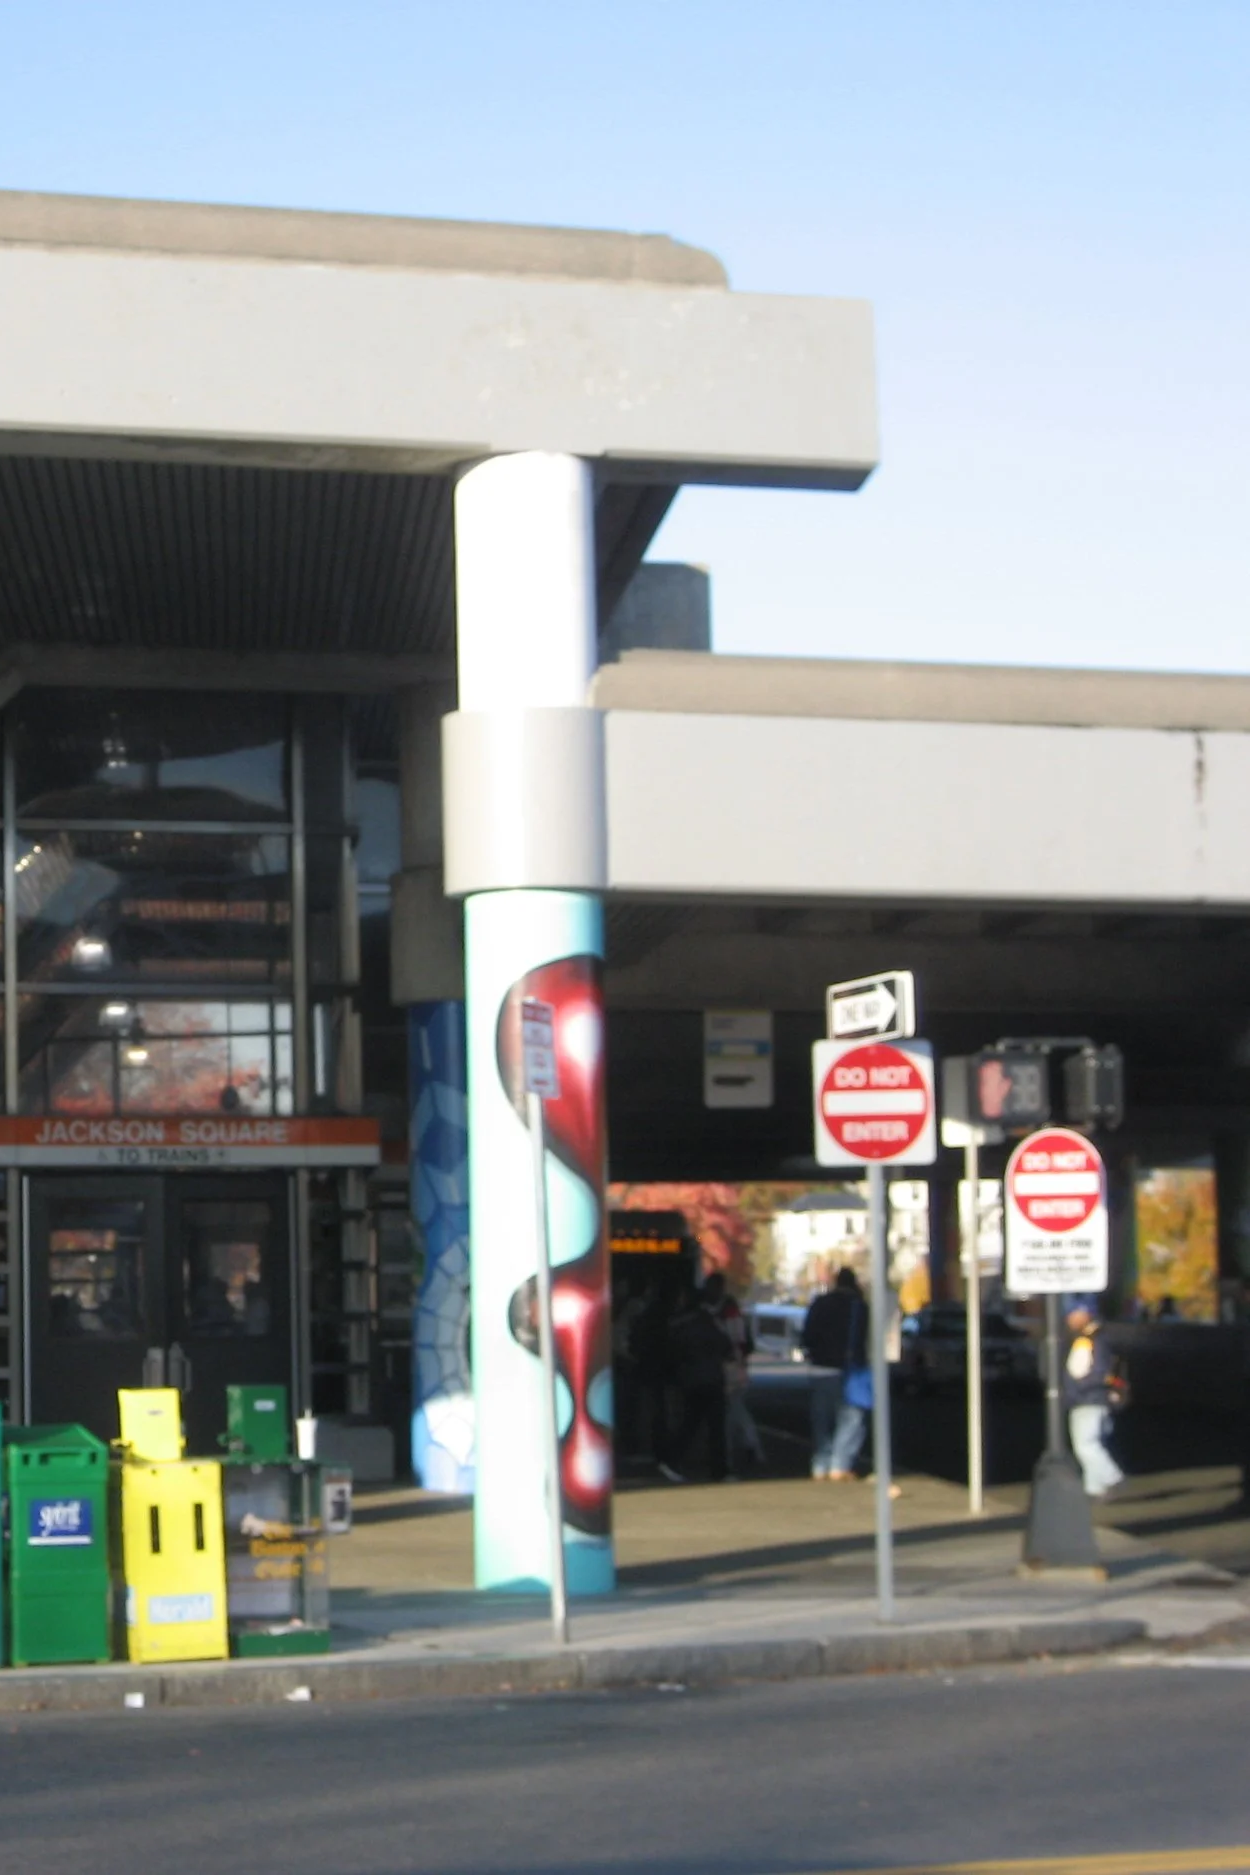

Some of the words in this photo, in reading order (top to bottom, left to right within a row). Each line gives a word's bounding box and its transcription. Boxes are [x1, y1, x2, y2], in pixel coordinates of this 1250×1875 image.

[834, 1066, 868, 1089] DO
[869, 1065, 912, 1088] NOT
[35, 1120, 165, 1144] JACKSON
[179, 1120, 289, 1144] SQUARE
[842, 1120, 910, 1143] ENTER
[117, 1149, 141, 1164] TO
[147, 1148, 210, 1163] TRAINS
[1021, 1151, 1050, 1171] DO
[1051, 1150, 1087, 1170] NOT
[1027, 1199, 1086, 1219] ENTER
